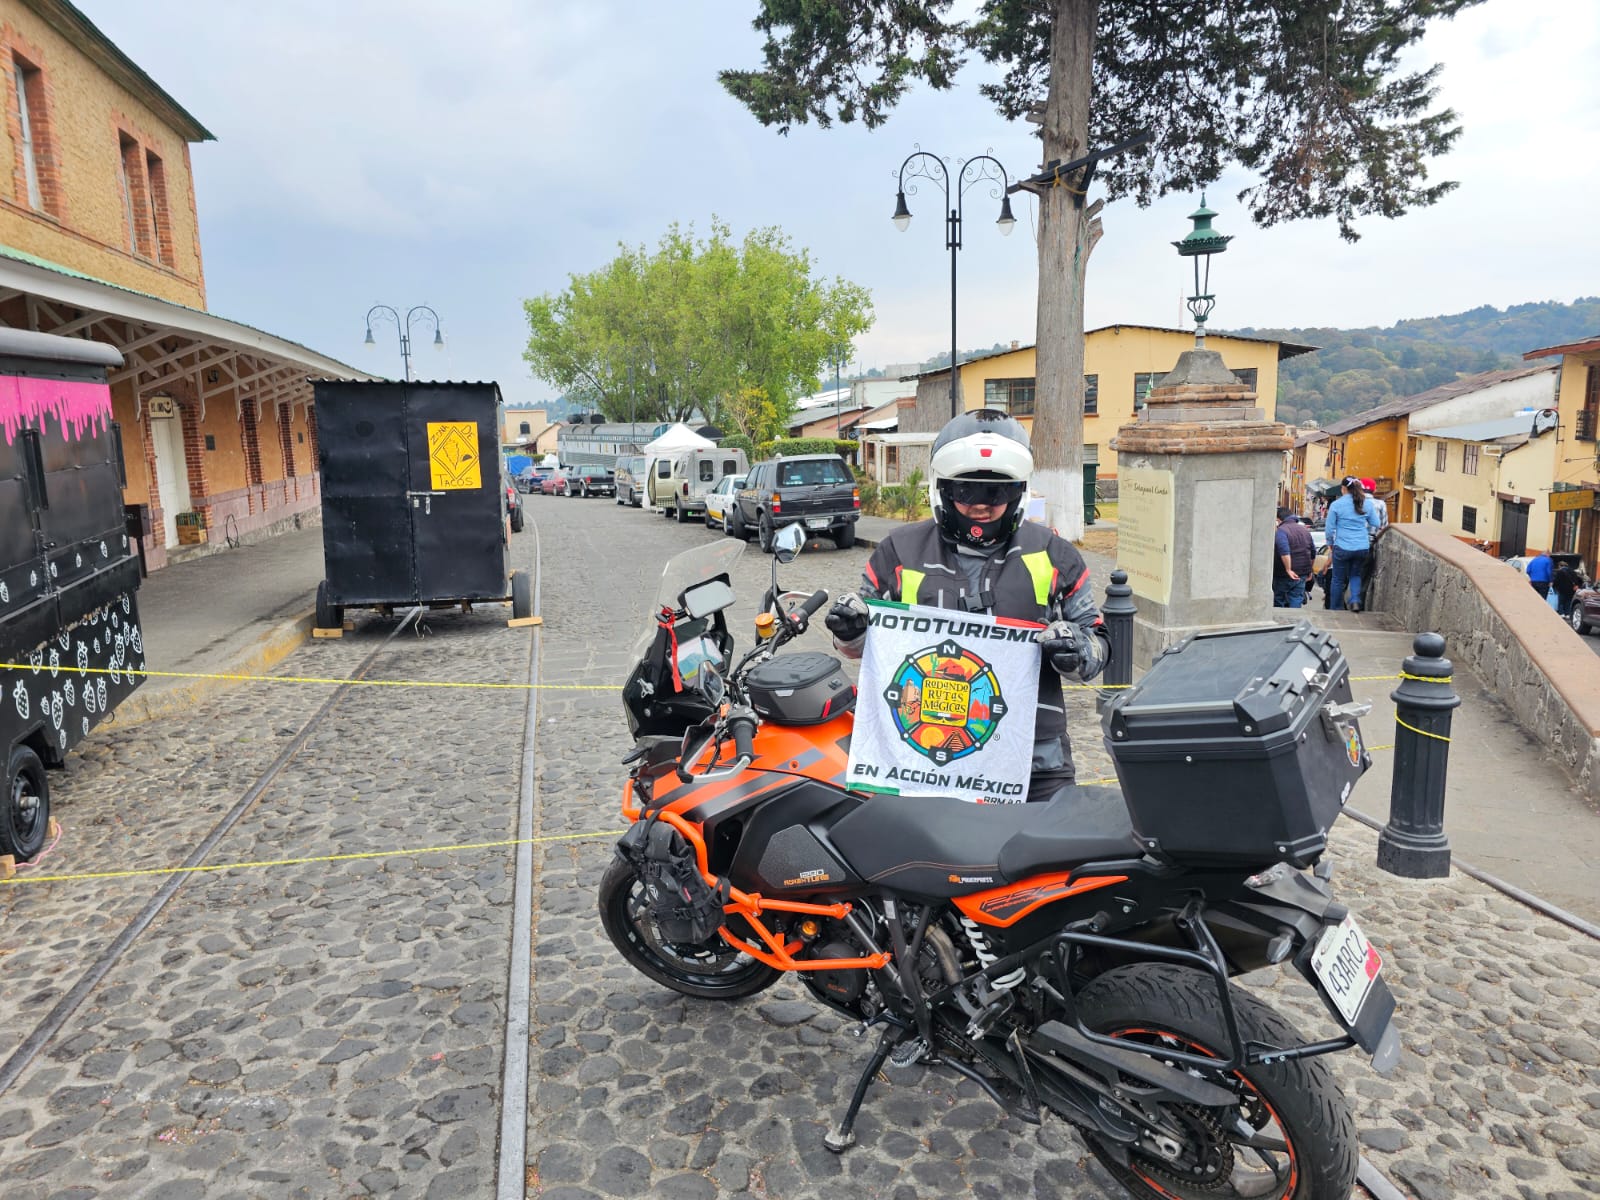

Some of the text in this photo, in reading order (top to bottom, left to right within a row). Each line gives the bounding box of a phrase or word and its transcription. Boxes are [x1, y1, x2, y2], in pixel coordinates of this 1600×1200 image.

[434, 473, 474, 488] TACOS
[943, 645, 956, 654] N
[992, 704, 1004, 713] E
[935, 751, 948, 761] S
[853, 763, 1023, 796] EN ACCIÓN MÉXICO
[1328, 929, 1368, 997] 43ARC2
